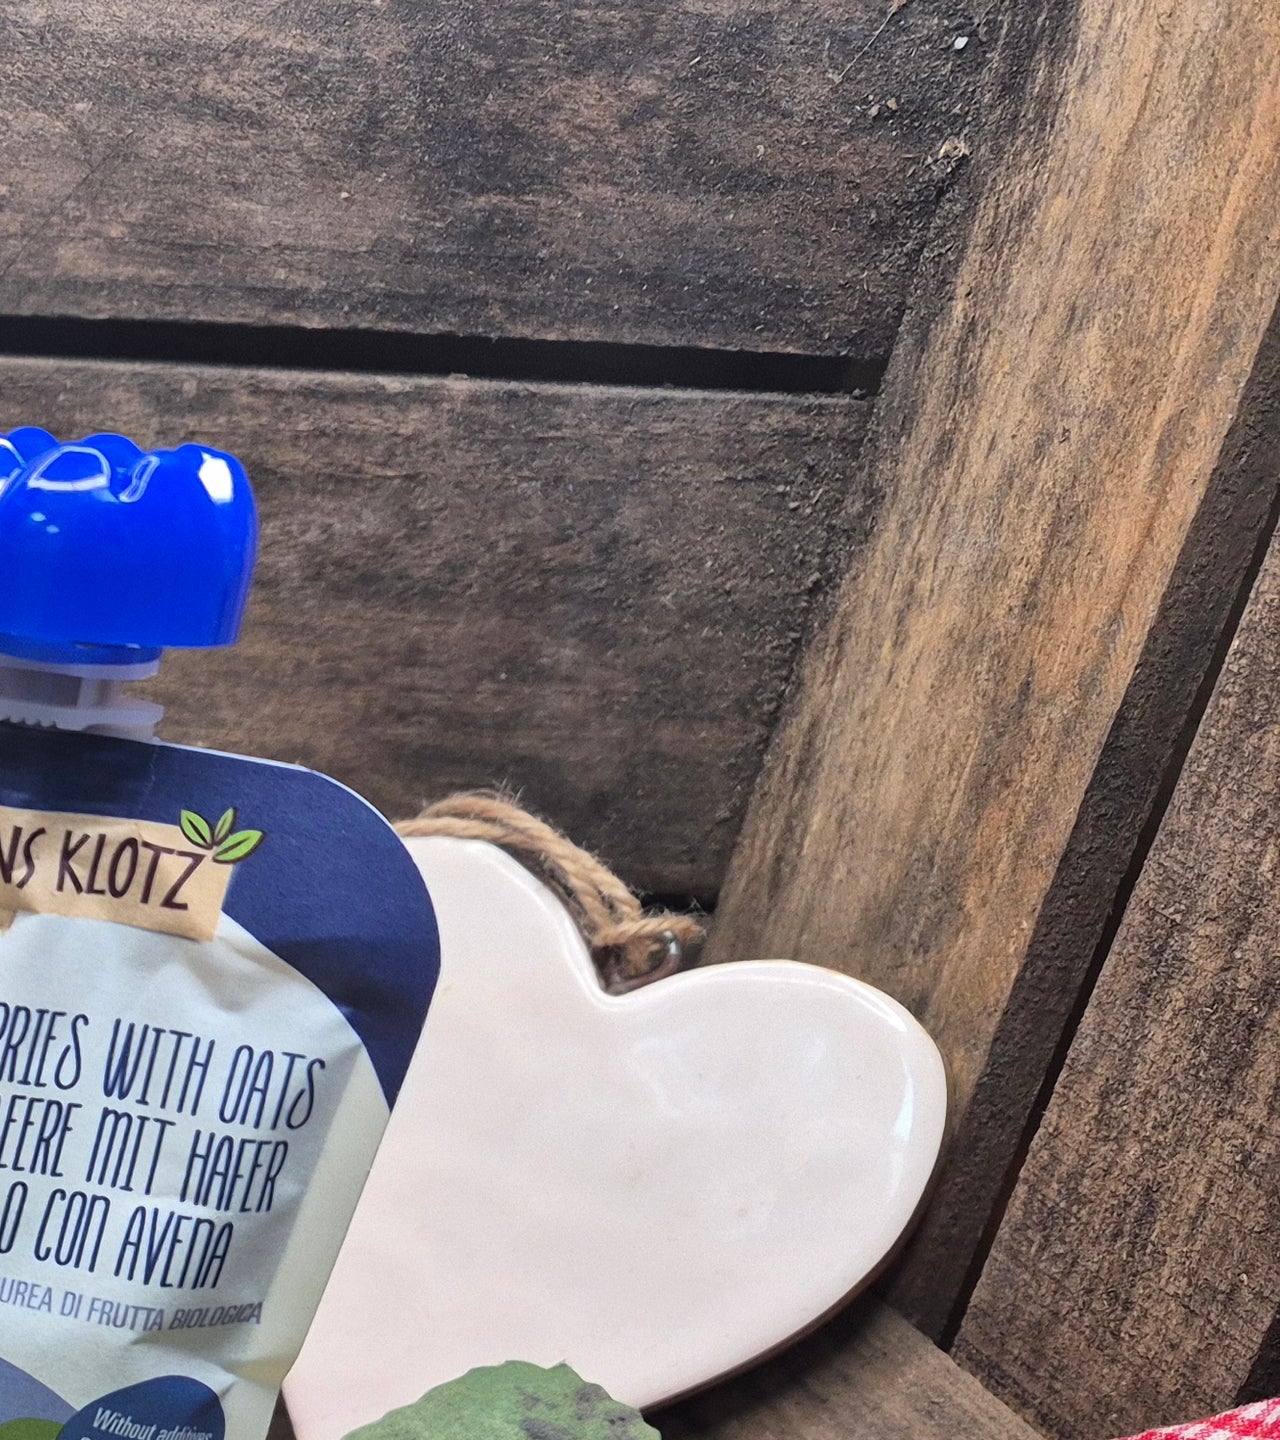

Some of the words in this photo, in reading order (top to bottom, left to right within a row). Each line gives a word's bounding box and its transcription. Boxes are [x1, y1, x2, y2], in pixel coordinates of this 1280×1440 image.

[56, 830, 207, 911] KLOTZ
[102, 1018, 216, 1116] WITH
[218, 1044, 326, 1130] OATS
[85, 1106, 177, 1195] MIT
[179, 1129, 289, 1213] HAFER
[33, 1188, 111, 1273] CON
[113, 1206, 235, 1290] AVENA
[60, 1290, 83, 1319] DI
[86, 1301, 165, 1332] FRUTTA
[168, 1301, 264, 1331] BIOLOGICA
